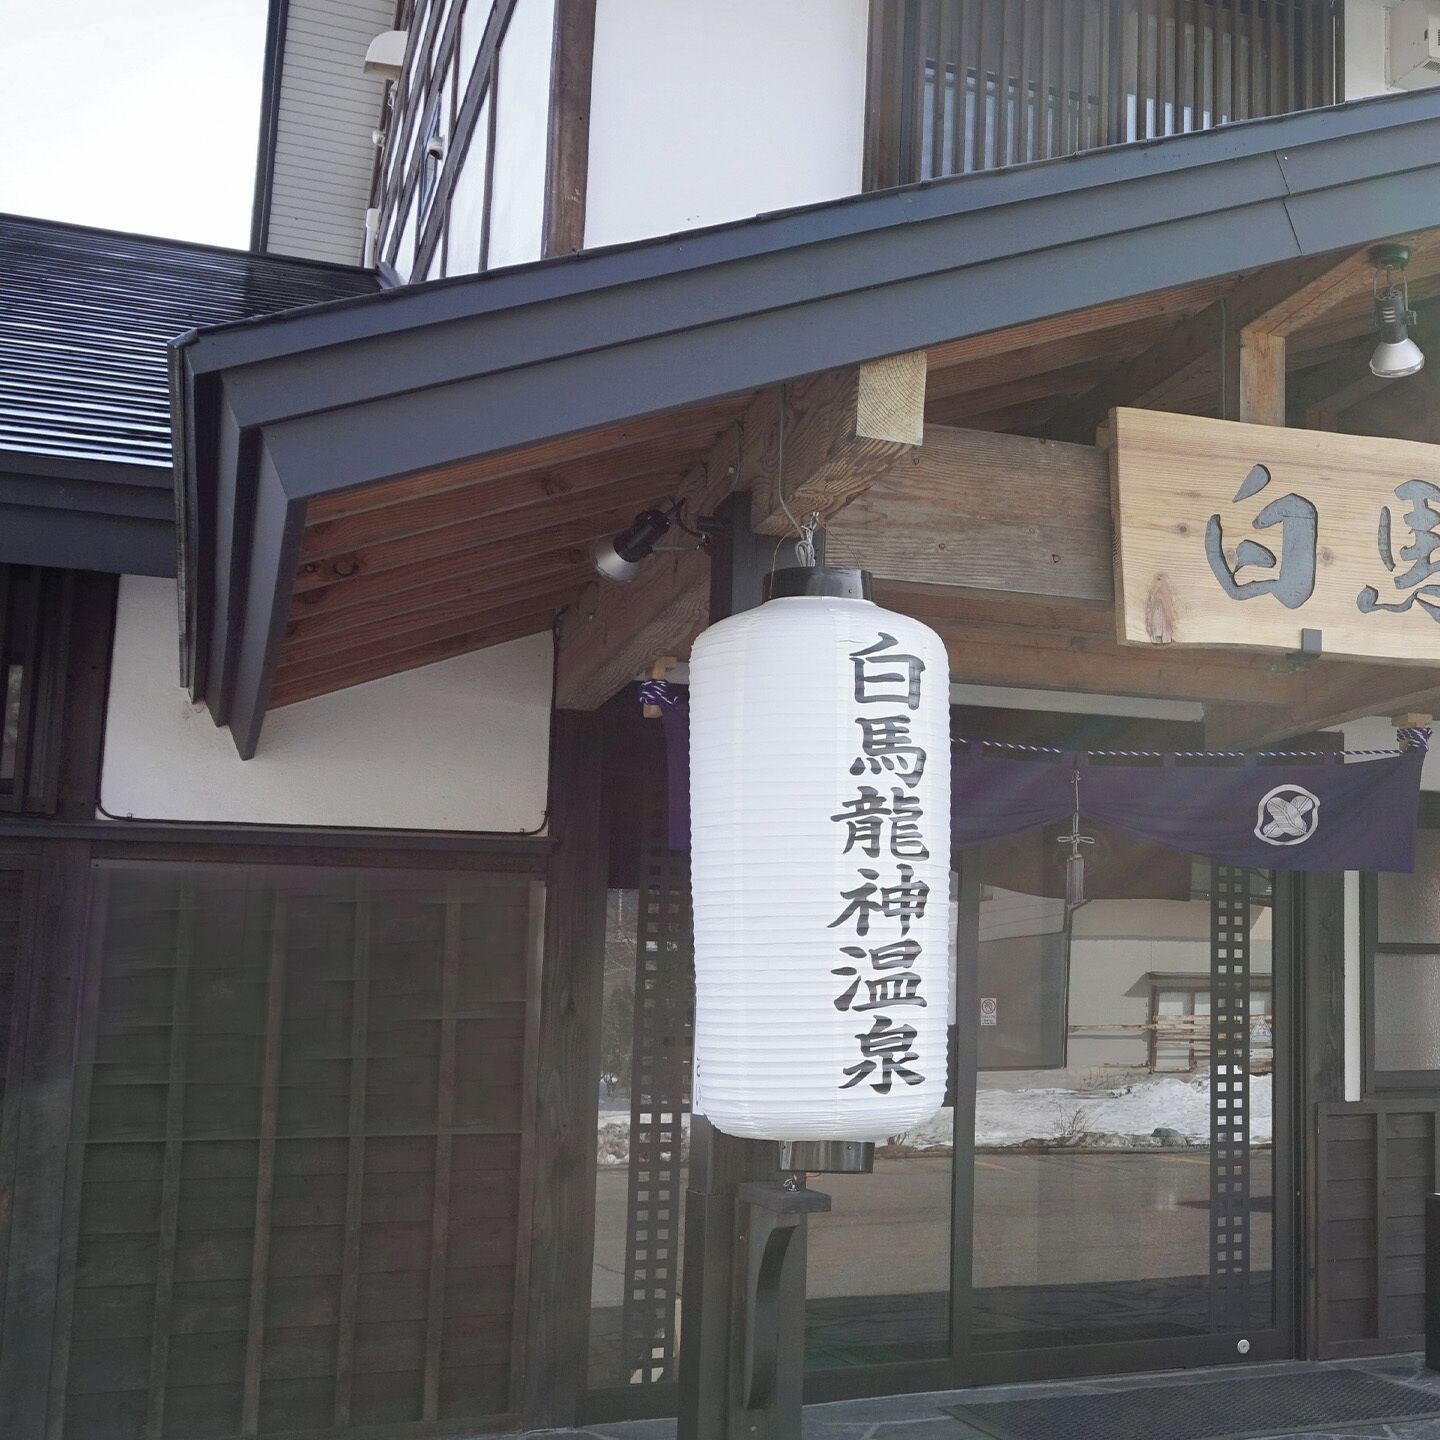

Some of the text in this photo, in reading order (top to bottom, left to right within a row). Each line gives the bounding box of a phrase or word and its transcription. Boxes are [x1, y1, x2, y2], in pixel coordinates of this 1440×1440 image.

[826, 632, 928, 1094] 白馬龍神温泉
